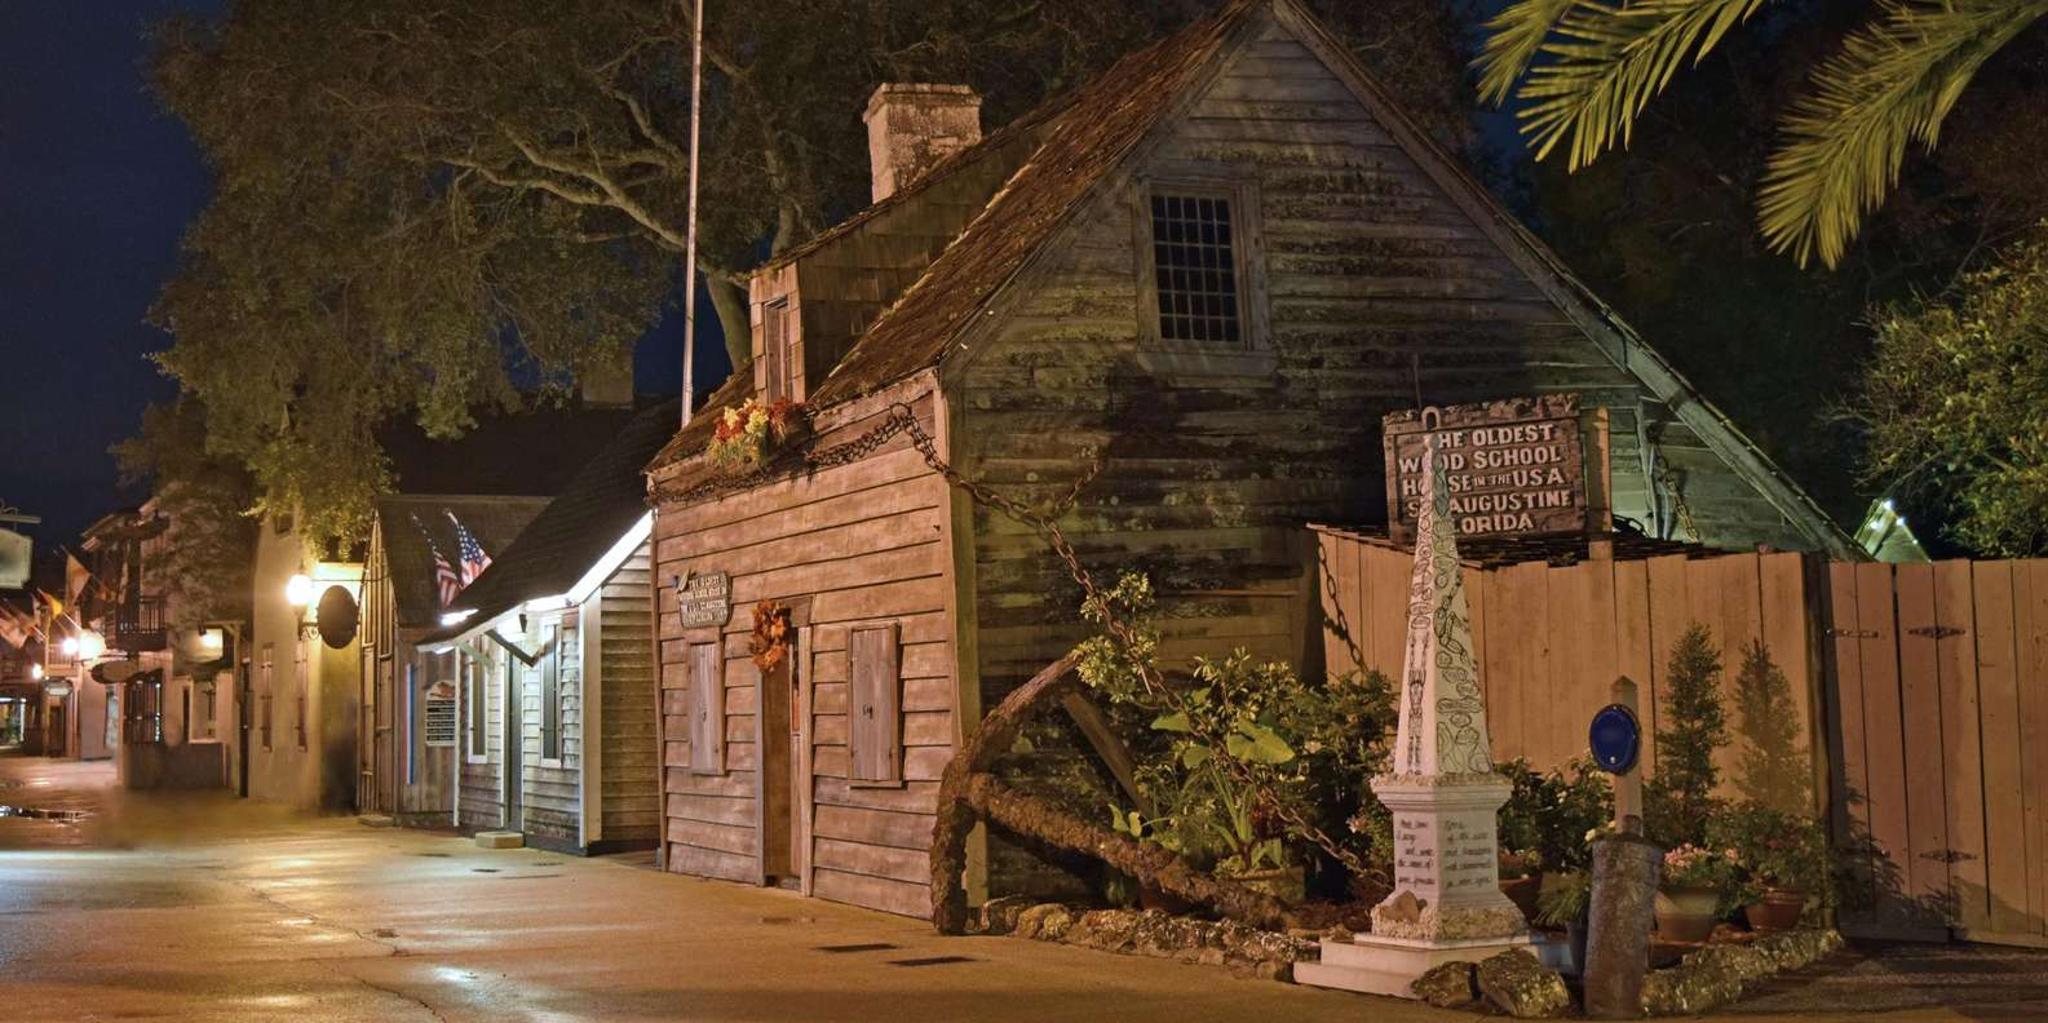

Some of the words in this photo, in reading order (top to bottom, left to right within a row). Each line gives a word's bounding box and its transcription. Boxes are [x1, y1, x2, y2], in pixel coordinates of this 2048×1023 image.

[1438, 431, 1464, 448] HE
[1472, 424, 1553, 446] OLDEST
[1399, 454, 1464, 473] WD
[1473, 446, 1560, 468] SCHOOL
[1402, 475, 1471, 495] HSE
[1474, 475, 1486, 487] IN
[1489, 473, 1512, 486] THE
[1449, 490, 1571, 513] AUGUSTINE
